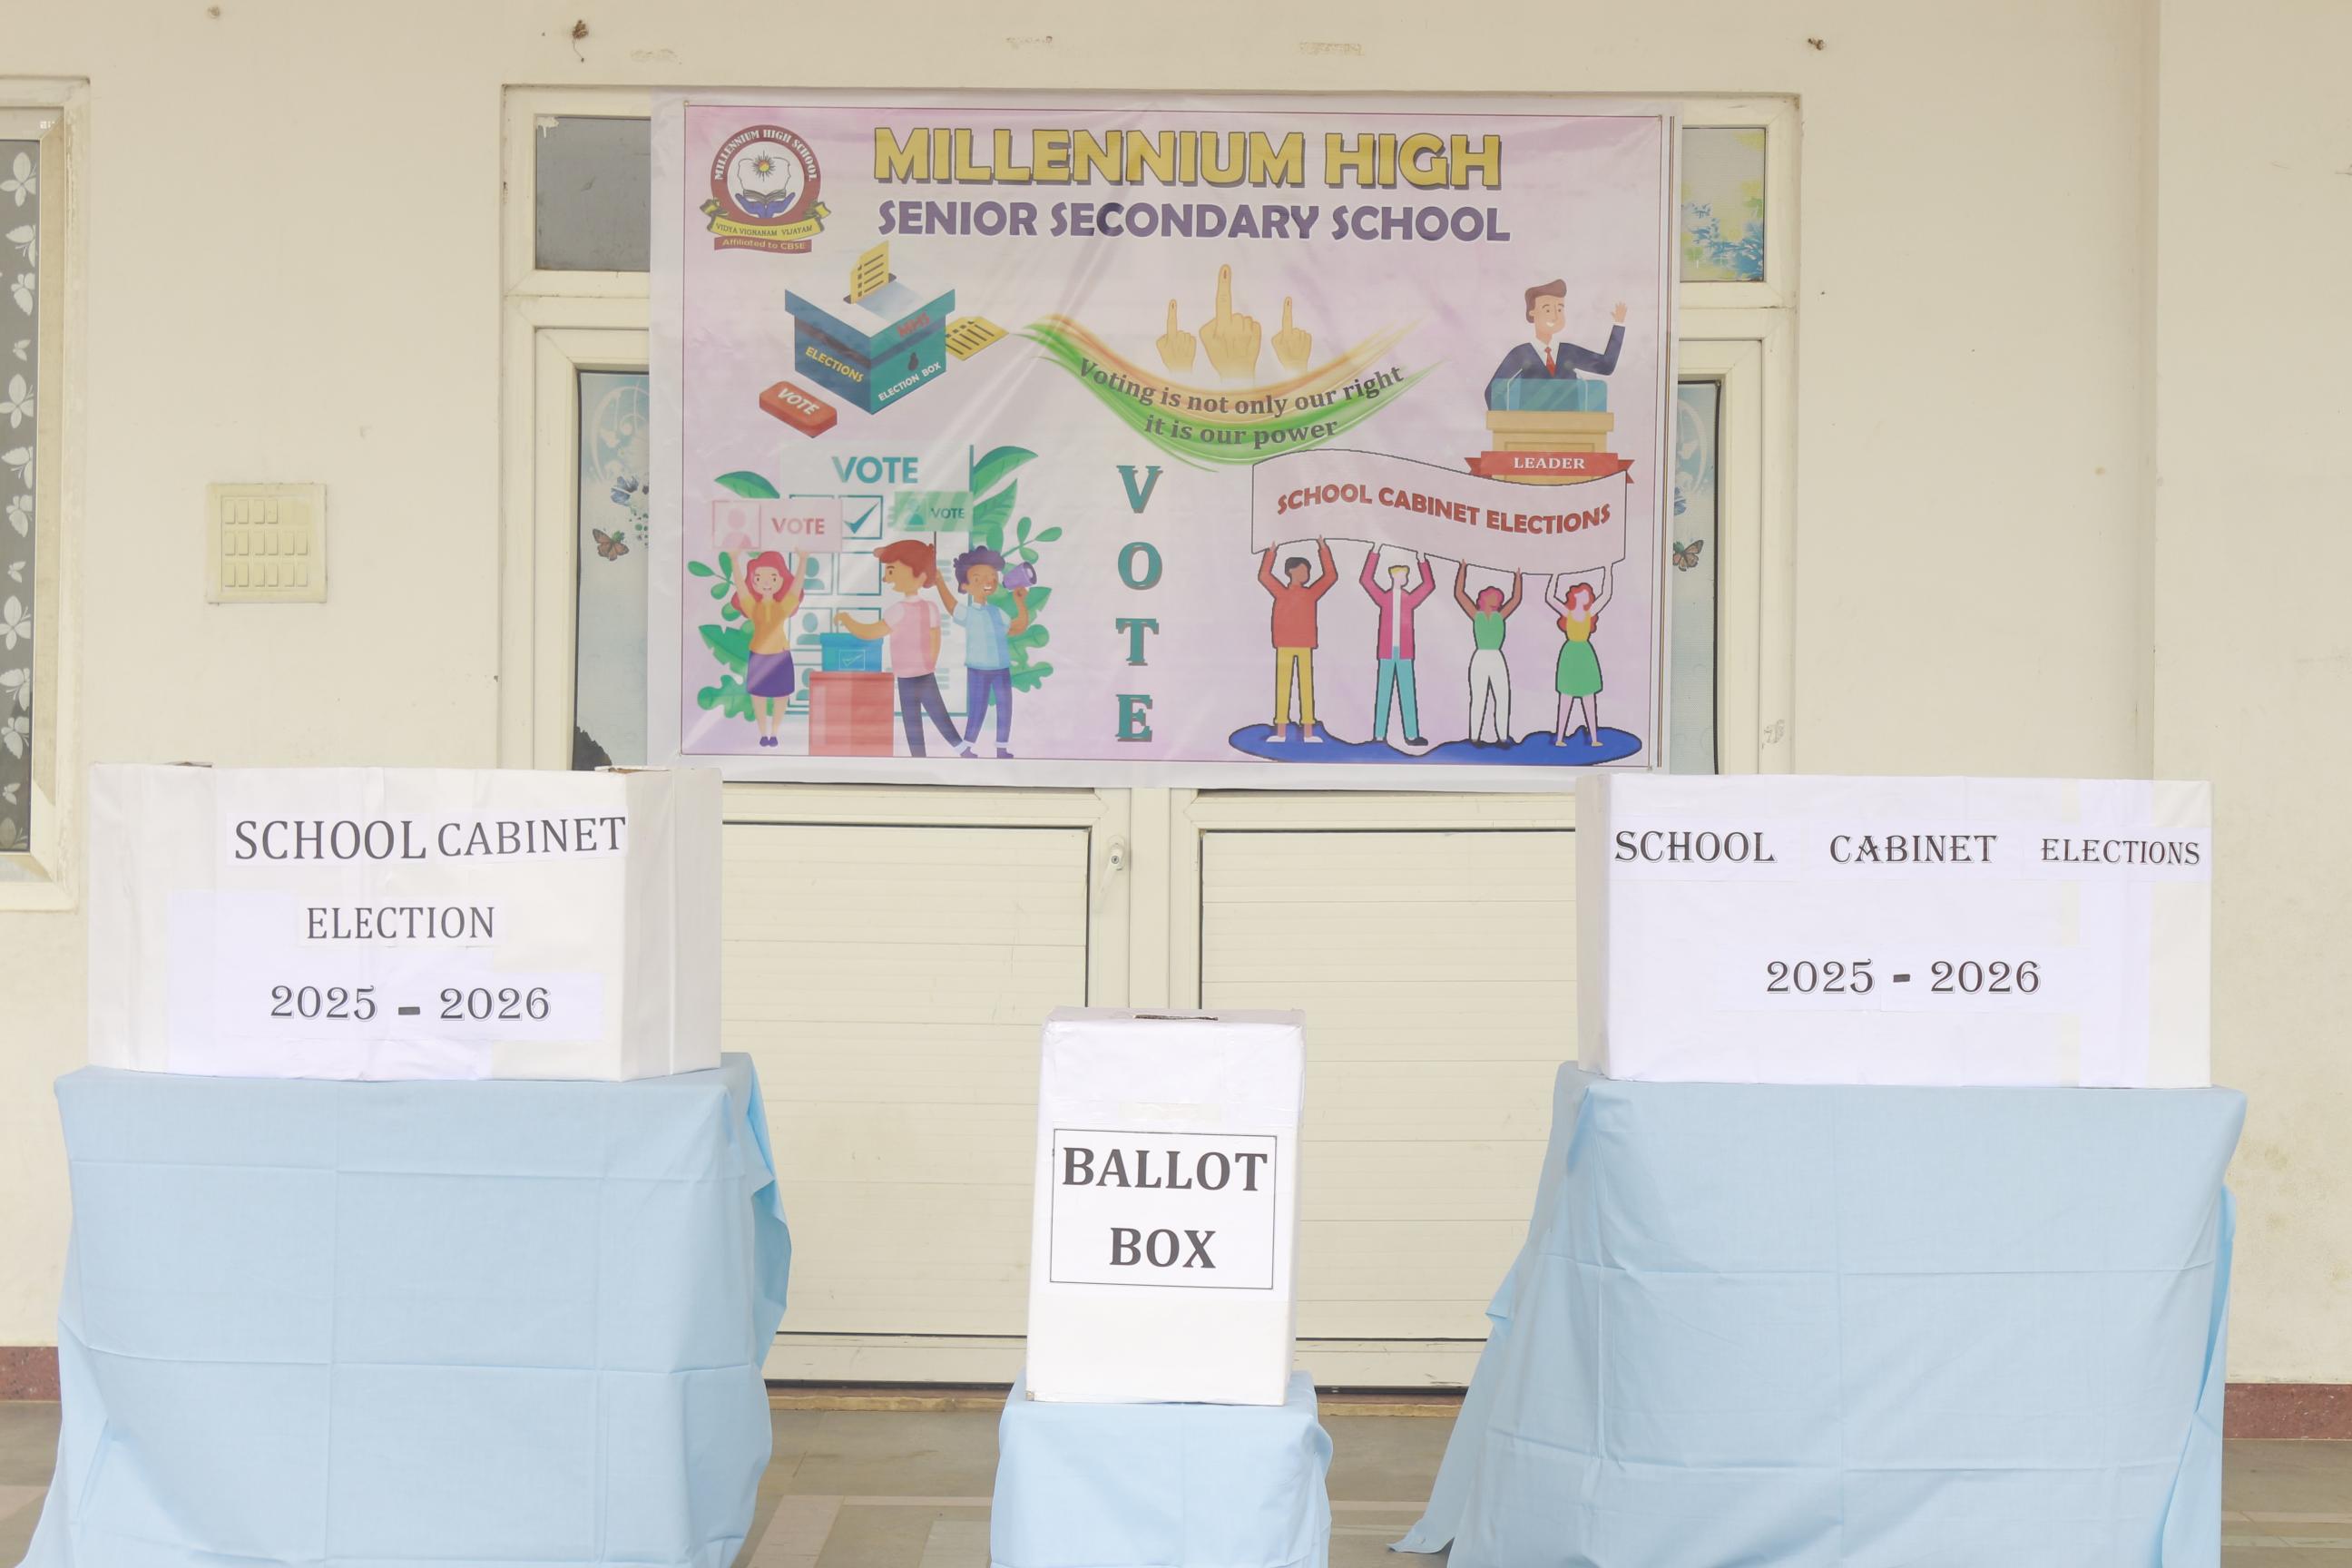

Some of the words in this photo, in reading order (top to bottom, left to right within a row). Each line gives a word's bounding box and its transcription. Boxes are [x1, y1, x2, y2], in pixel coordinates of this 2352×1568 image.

[715, 130, 760, 181] MILLENNIUM
[763, 129, 792, 142] HIGH
[792, 139, 818, 181] SCHOOL
[875, 127, 1305, 188] MILLENNIUM
[1325, 132, 1502, 190] HIGH
[715, 222, 738, 233] VIDYA
[878, 200, 1038, 235] SENIOR
[1050, 201, 1319, 239] SECONDARY
[1331, 205, 1511, 241] SCHOOL
[722, 239, 766, 249] Affiliated
[768, 240, 778, 249] to
[780, 241, 805, 250] CBSE
[805, 346, 864, 383] ELECTIONS
[878, 373, 919, 401] ELECTION
[922, 361, 942, 378] BOX
[778, 388, 819, 416] VOTE
[1079, 357, 1156, 407] Voting
[1161, 387, 1181, 407] is
[1187, 396, 1229, 414] not
[1235, 395, 1288, 417] only
[1295, 389, 1337, 411] our
[1343, 367, 1405, 399] right
[1144, 414, 1165, 436] it
[1170, 420, 1192, 440] is
[1200, 427, 1247, 445] our
[1254, 420, 1338, 449] power
[832, 456, 918, 485] VOTE
[1513, 457, 1586, 470] LEADER
[771, 517, 825, 535] VOTE
[930, 508, 965, 519] VOTE
[1277, 483, 1373, 514] SCHOOL
[1378, 486, 1480, 525] CABINET
[1486, 503, 1611, 534] ELECTIONS
[1117, 465, 1163, 743] VOTE
[235, 819, 426, 859] SCHOOL
[437, 816, 626, 857] CABINET
[1614, 829, 1778, 864] SCHOOL
[1829, 834, 1998, 863] CABINET
[2042, 838, 2201, 866] ELECTIONS
[307, 906, 495, 940] ELECTION
[1766, 958, 1875, 995] 2025
[1931, 960, 2042, 995] 2026
[270, 985, 377, 1021] 2025
[439, 986, 552, 1021] 2026
[1063, 1147, 1268, 1191] BALLOT
[1109, 1227, 1217, 1269] BOX
